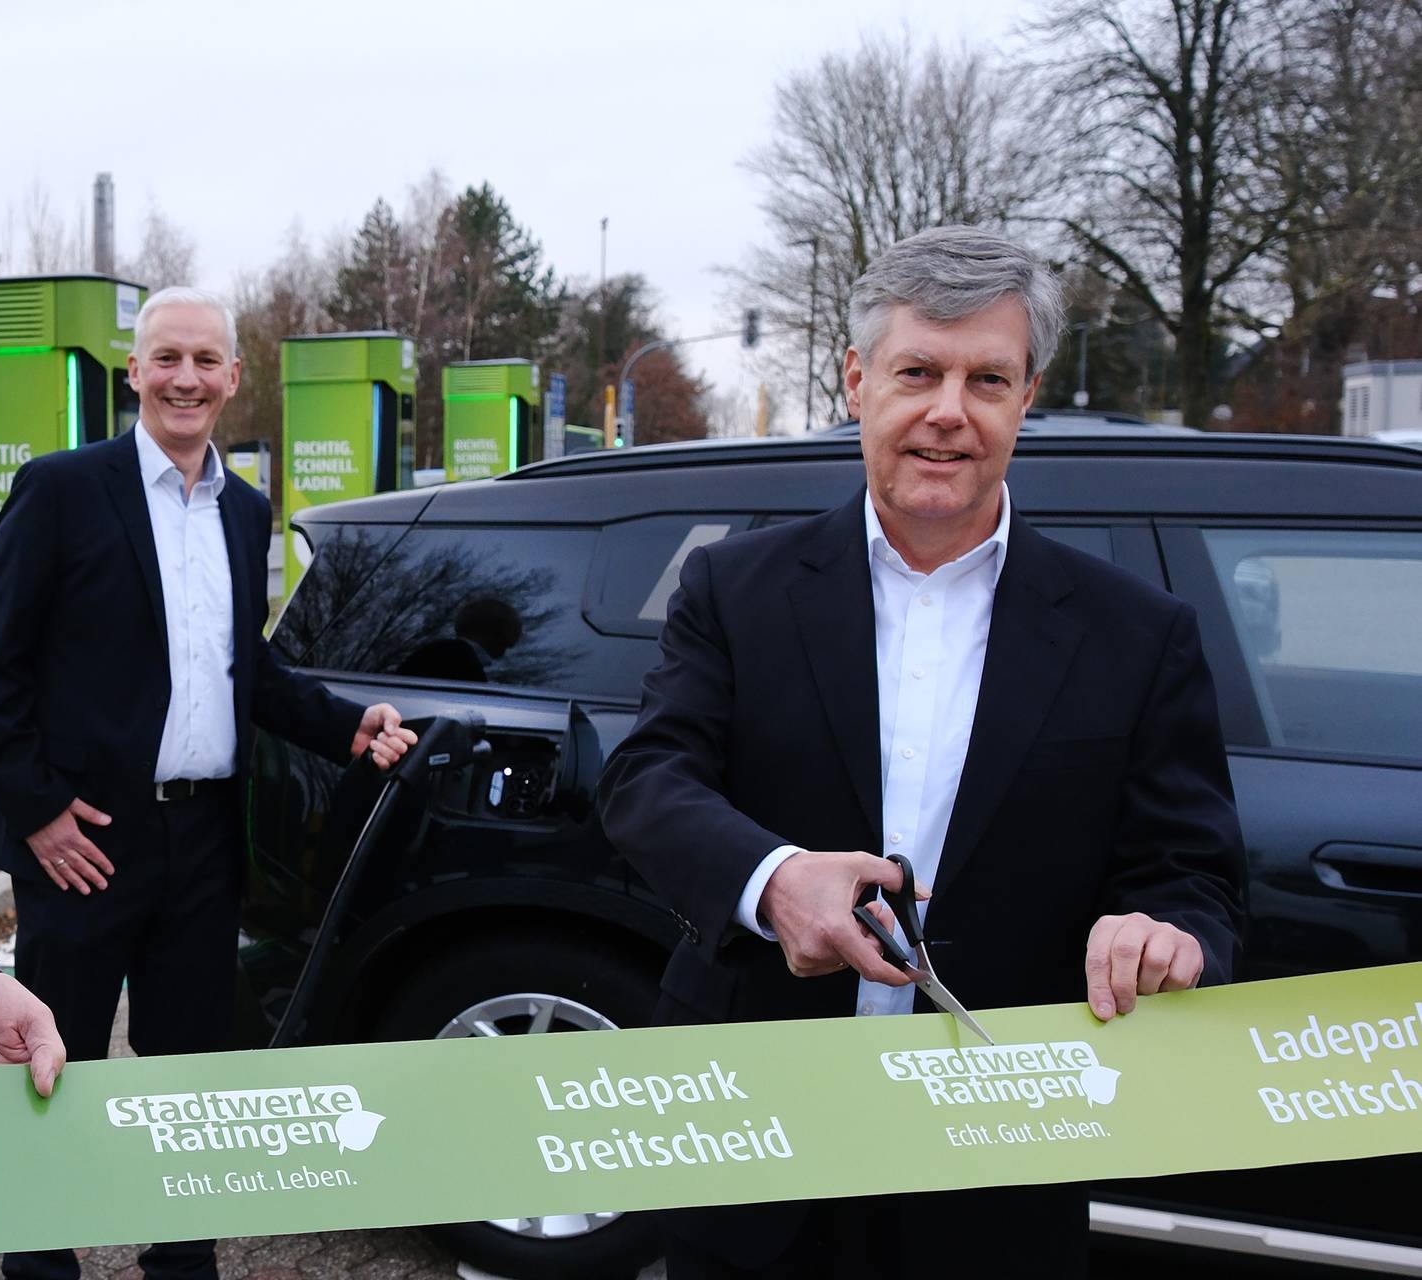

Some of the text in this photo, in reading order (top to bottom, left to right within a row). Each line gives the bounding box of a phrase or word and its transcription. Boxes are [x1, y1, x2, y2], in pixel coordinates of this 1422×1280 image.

[1249, 1002, 1422, 1063] Ladepar
[887, 1042, 1093, 1080] Stadtwerke
[113, 1086, 354, 1125] Stadtwerke
[534, 1060, 749, 1115] Ladepark
[921, 1074, 1086, 1109] Ratingen
[149, 1120, 338, 1156] Ratingen
[536, 1116, 794, 1173] Breitscheid
[946, 1117, 1112, 1147] Echt. Gut. Leben.
[162, 1166, 358, 1197] Echt. Gut. Leben.
